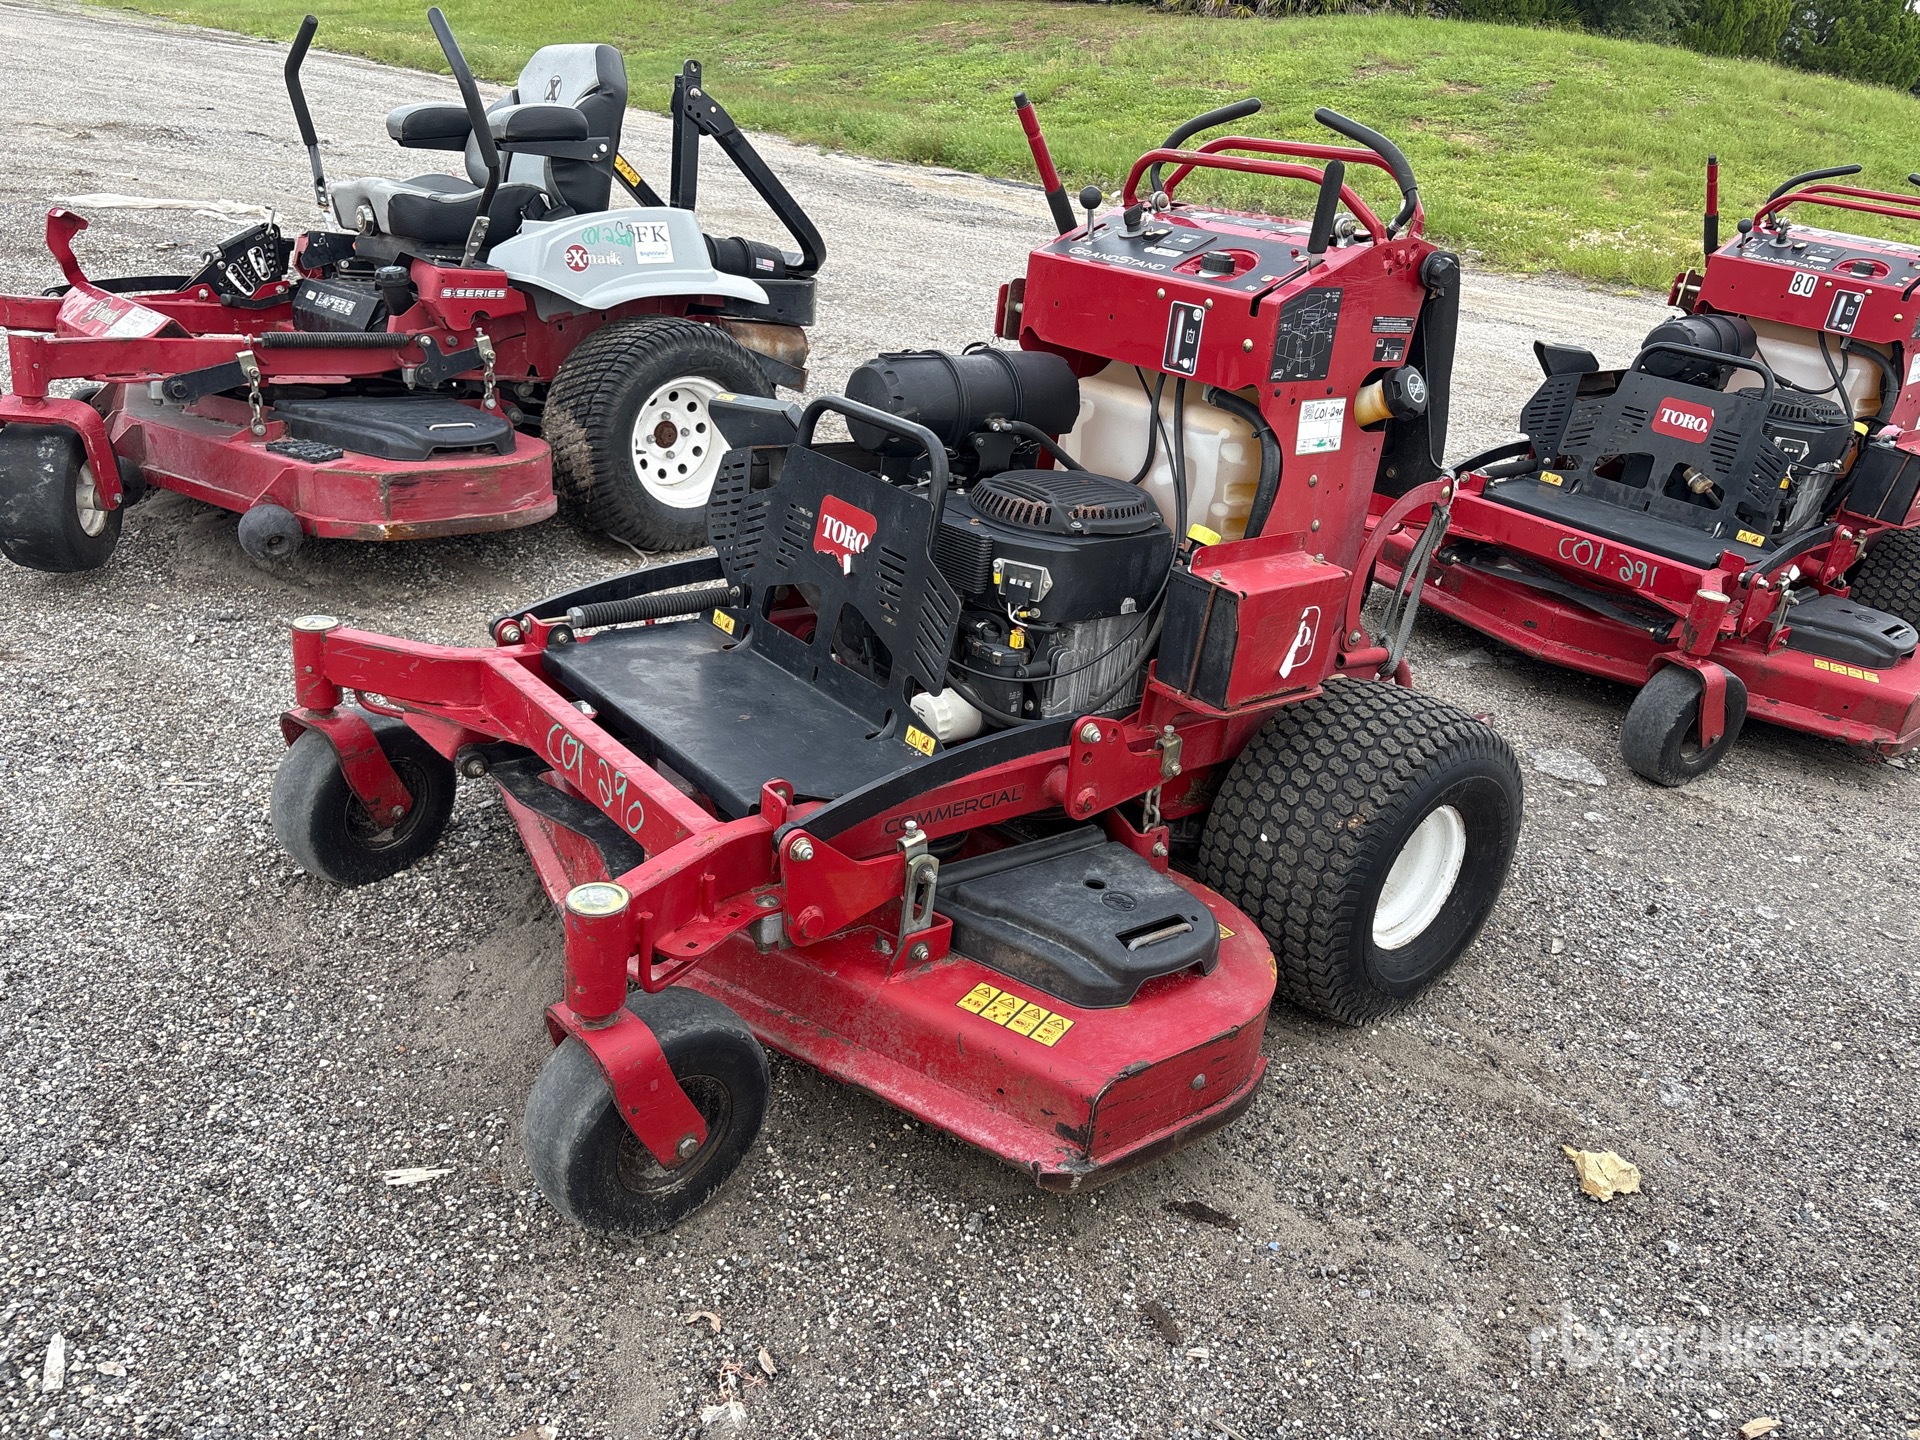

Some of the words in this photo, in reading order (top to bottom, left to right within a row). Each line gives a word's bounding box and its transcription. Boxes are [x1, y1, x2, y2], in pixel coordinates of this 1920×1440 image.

[1792, 274, 1815, 295] 80
[822, 514, 869, 554] TORO
[884, 785, 1022, 834] COMMERCIAL
